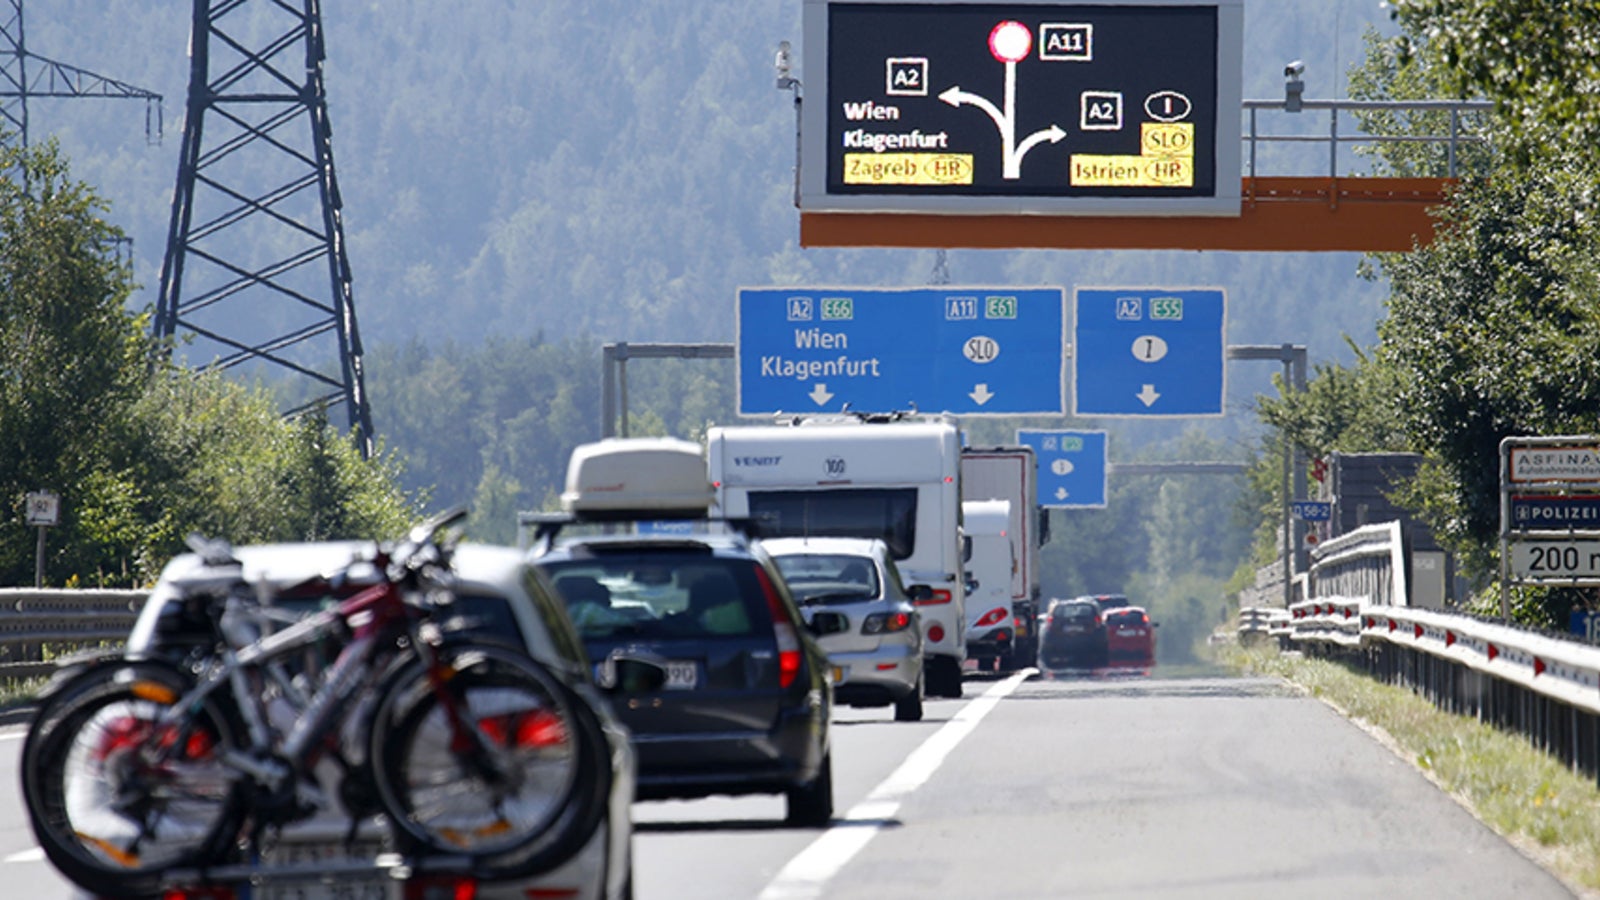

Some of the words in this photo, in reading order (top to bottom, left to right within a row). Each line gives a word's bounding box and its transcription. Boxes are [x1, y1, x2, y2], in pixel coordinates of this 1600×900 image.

[1047, 33, 1083, 50] A11
[894, 69, 920, 86] A2
[843, 101, 899, 120] Wien
[1089, 102, 1114, 119] A2
[1164, 97, 1172, 114] I
[844, 129, 948, 152] Klagenfurt
[1150, 132, 1187, 148] SLO
[850, 159, 917, 180] Zagreb
[934, 160, 961, 176] HR
[1076, 162, 1139, 179] Istrien
[1155, 162, 1182, 178] HR
[791, 301, 809, 318] A2
[824, 301, 851, 318] E66
[951, 301, 974, 317] A11
[990, 299, 1015, 316] E61
[1120, 301, 1139, 317] A2
[1152, 301, 1181, 317] E55
[795, 328, 848, 349] Wien
[968, 339, 995, 360] SLO
[1145, 339, 1153, 359] I
[761, 356, 880, 380] Klagenfurt
[1532, 507, 1597, 519] POLIZEI
[1529, 546, 1579, 571] 200
